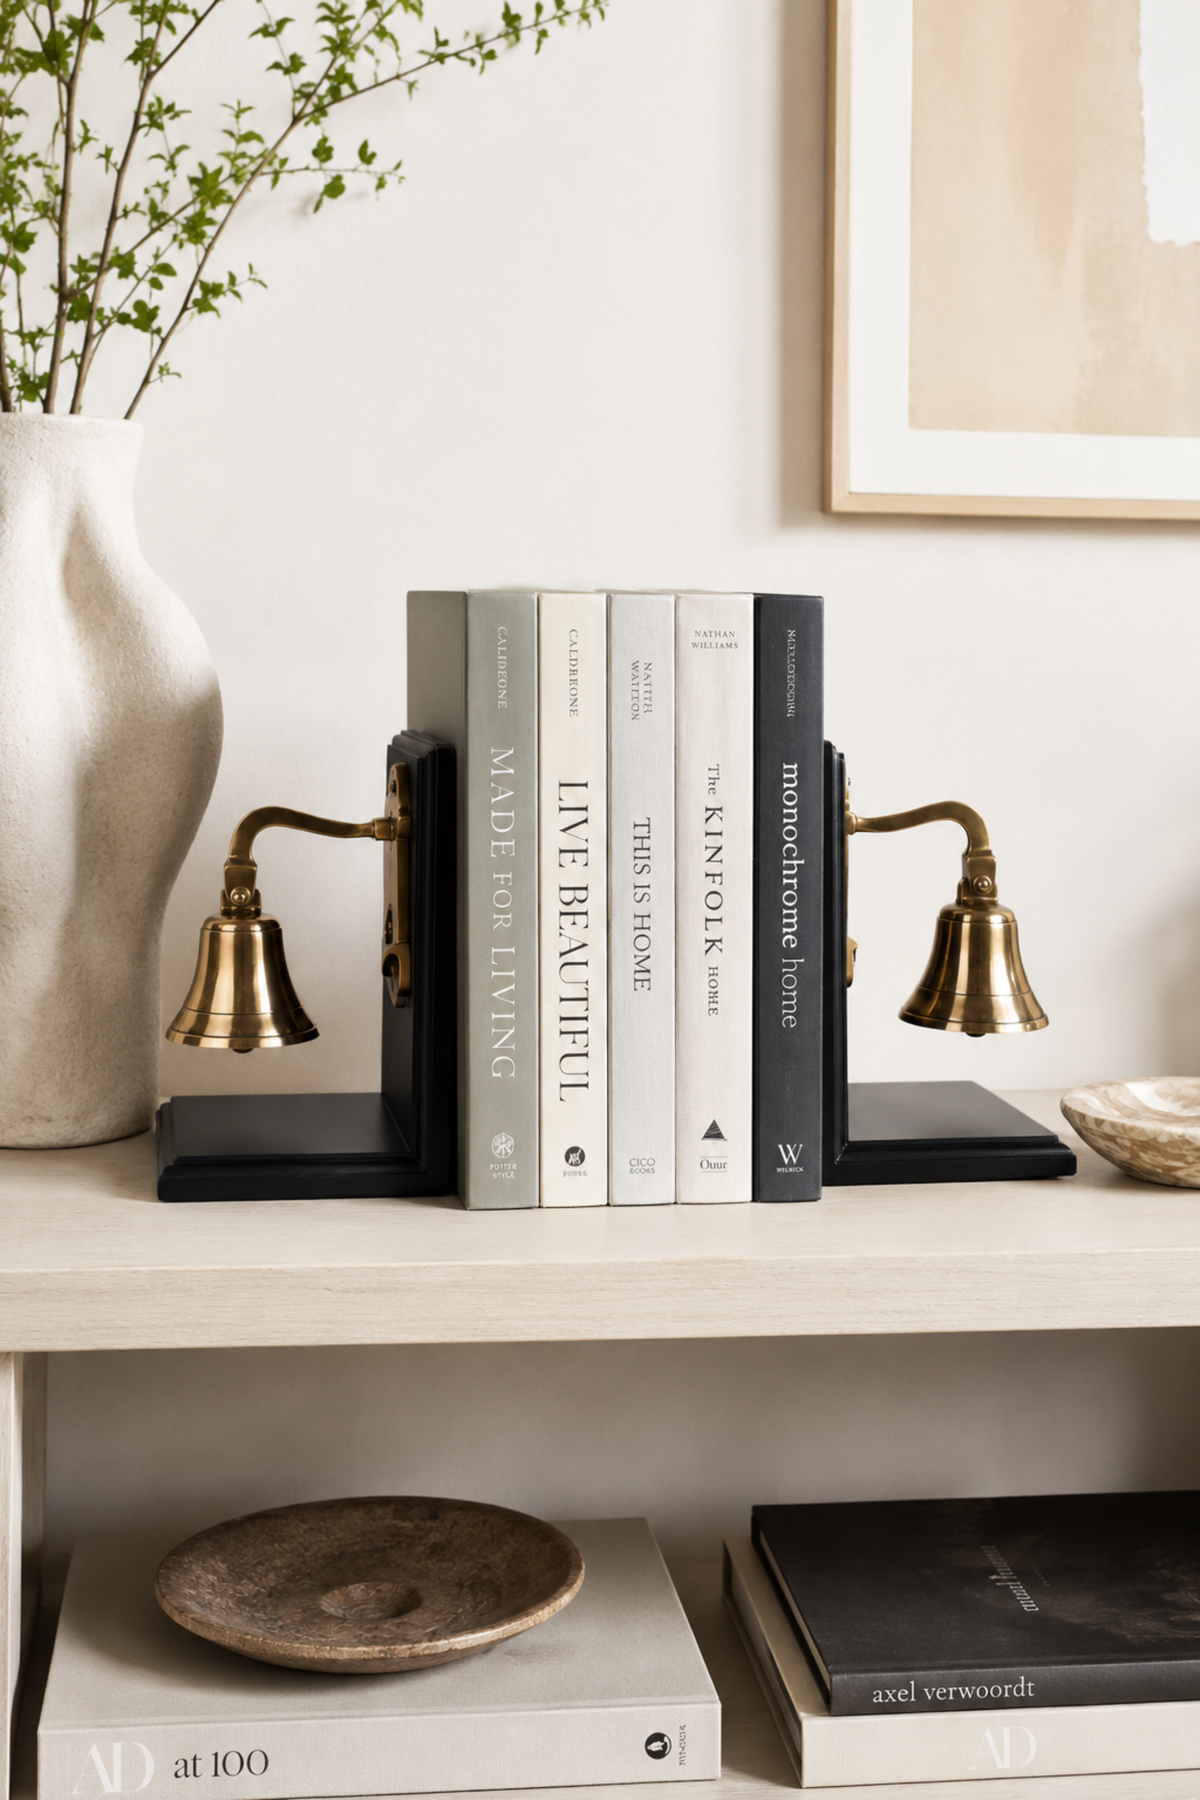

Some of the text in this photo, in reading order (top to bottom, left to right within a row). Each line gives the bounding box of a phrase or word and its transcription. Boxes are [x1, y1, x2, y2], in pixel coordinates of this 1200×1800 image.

[694, 630, 736, 638] NATHAN
[707, 763, 720, 796] The
[632, 816, 652, 992] THIS IS HOME
[704, 805, 724, 957] KINFOLK
[781, 762, 805, 1029] monochrome home
[491, 747, 516, 1078] MADE FOR LIVING
[559, 780, 589, 1102] LIVE BEAUTIFUL
[629, 1157, 656, 1168] CICO
[777, 1143, 804, 1165] W
[872, 1675, 1036, 1704] axel verwoordt
[70, 1741, 269, 1795] AD at 100
[968, 1725, 1037, 1771] AD
